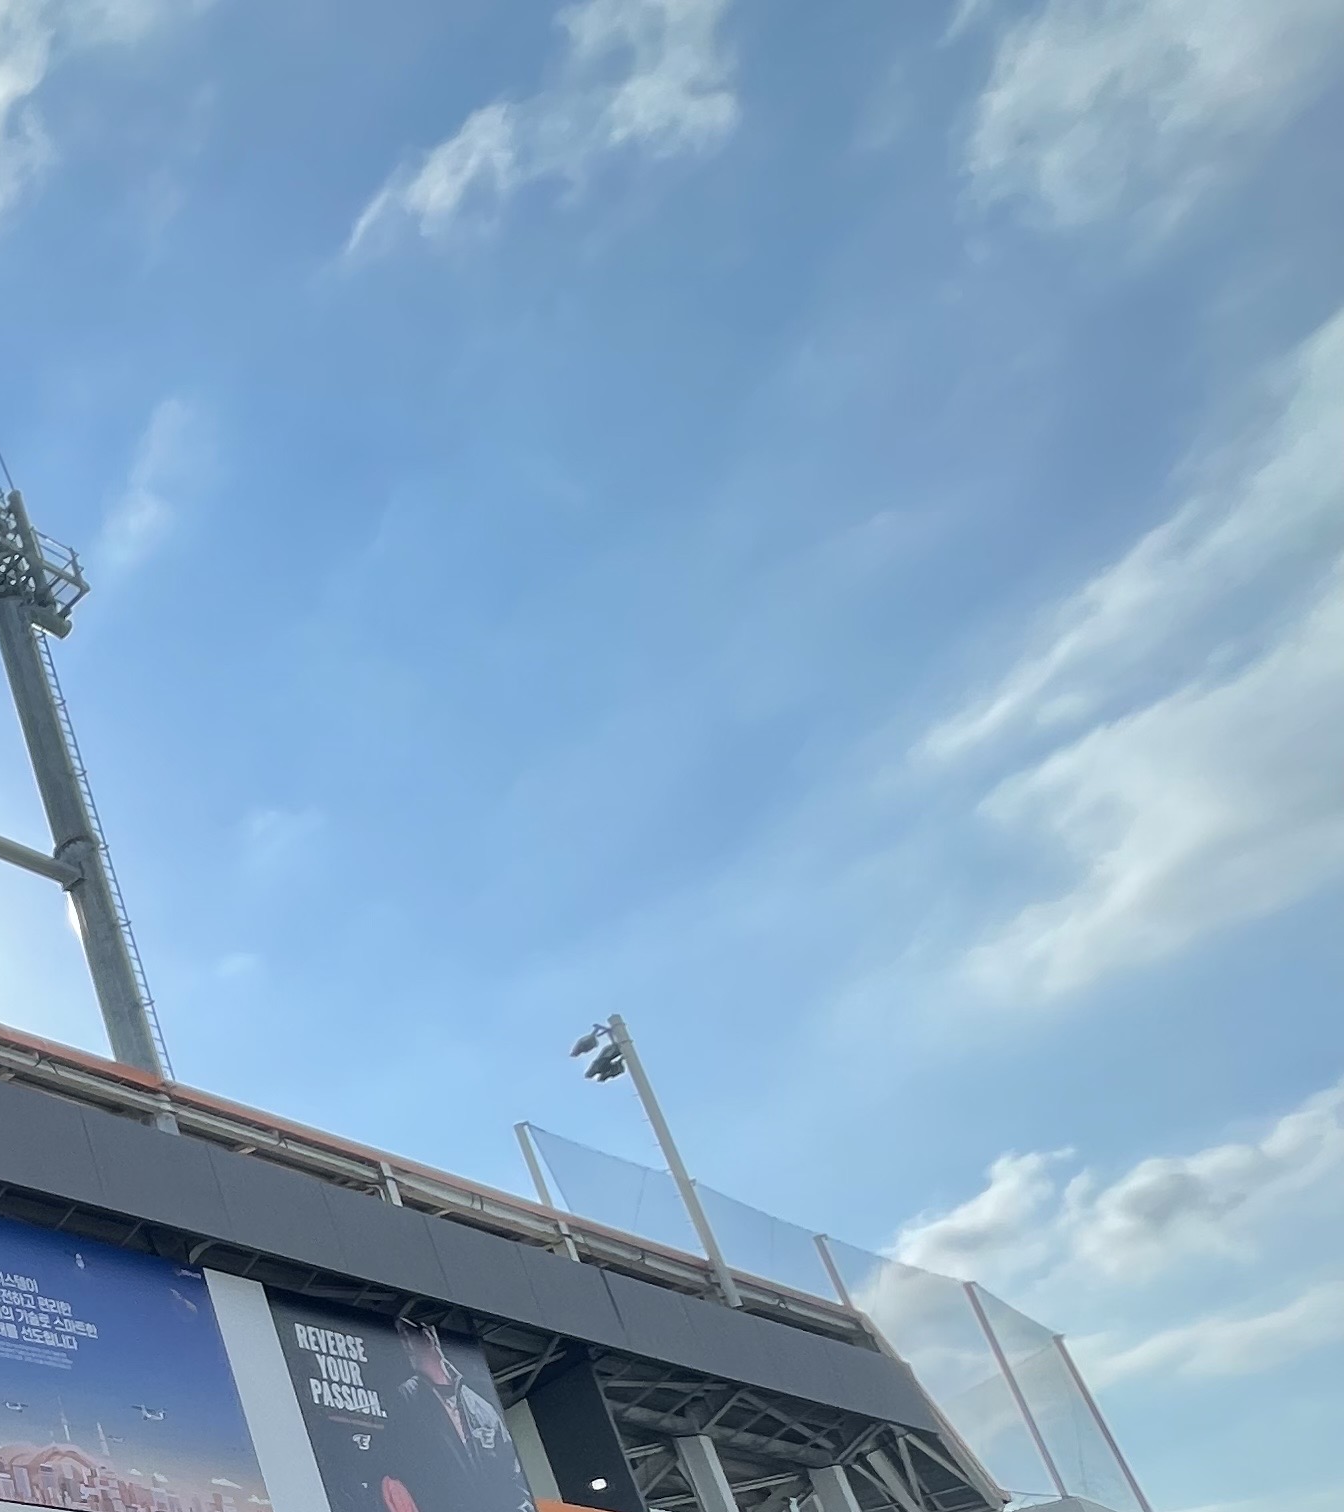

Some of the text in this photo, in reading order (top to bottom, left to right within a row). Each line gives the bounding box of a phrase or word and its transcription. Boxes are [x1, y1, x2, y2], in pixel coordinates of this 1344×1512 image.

[16, 1308, 52, 1328] 기술로
[295, 1323, 368, 1362] REVERSE
[316, 1353, 363, 1386] YOUR
[310, 1378, 388, 1418] PASSION.
